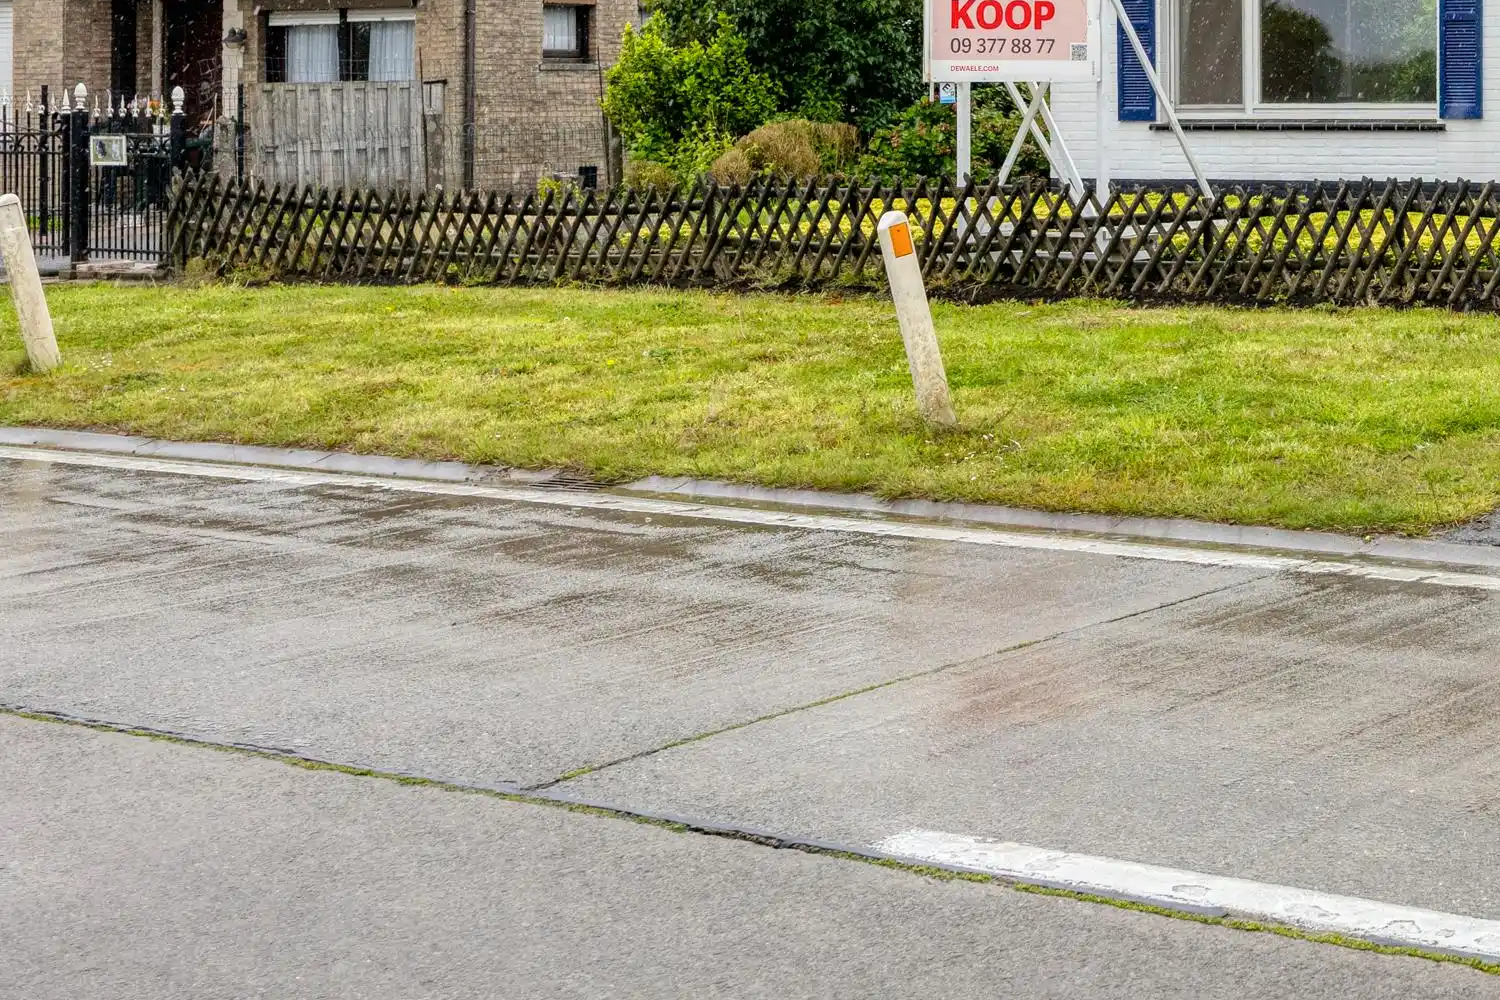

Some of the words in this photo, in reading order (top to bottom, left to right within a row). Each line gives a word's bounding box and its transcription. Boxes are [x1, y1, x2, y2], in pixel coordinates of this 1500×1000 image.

[951, 0, 1055, 30] KOOP
[950, 37, 972, 54] 09
[976, 38, 1007, 54] 377
[1011, 38, 1032, 54] 88
[1035, 38, 1056, 54] 77
